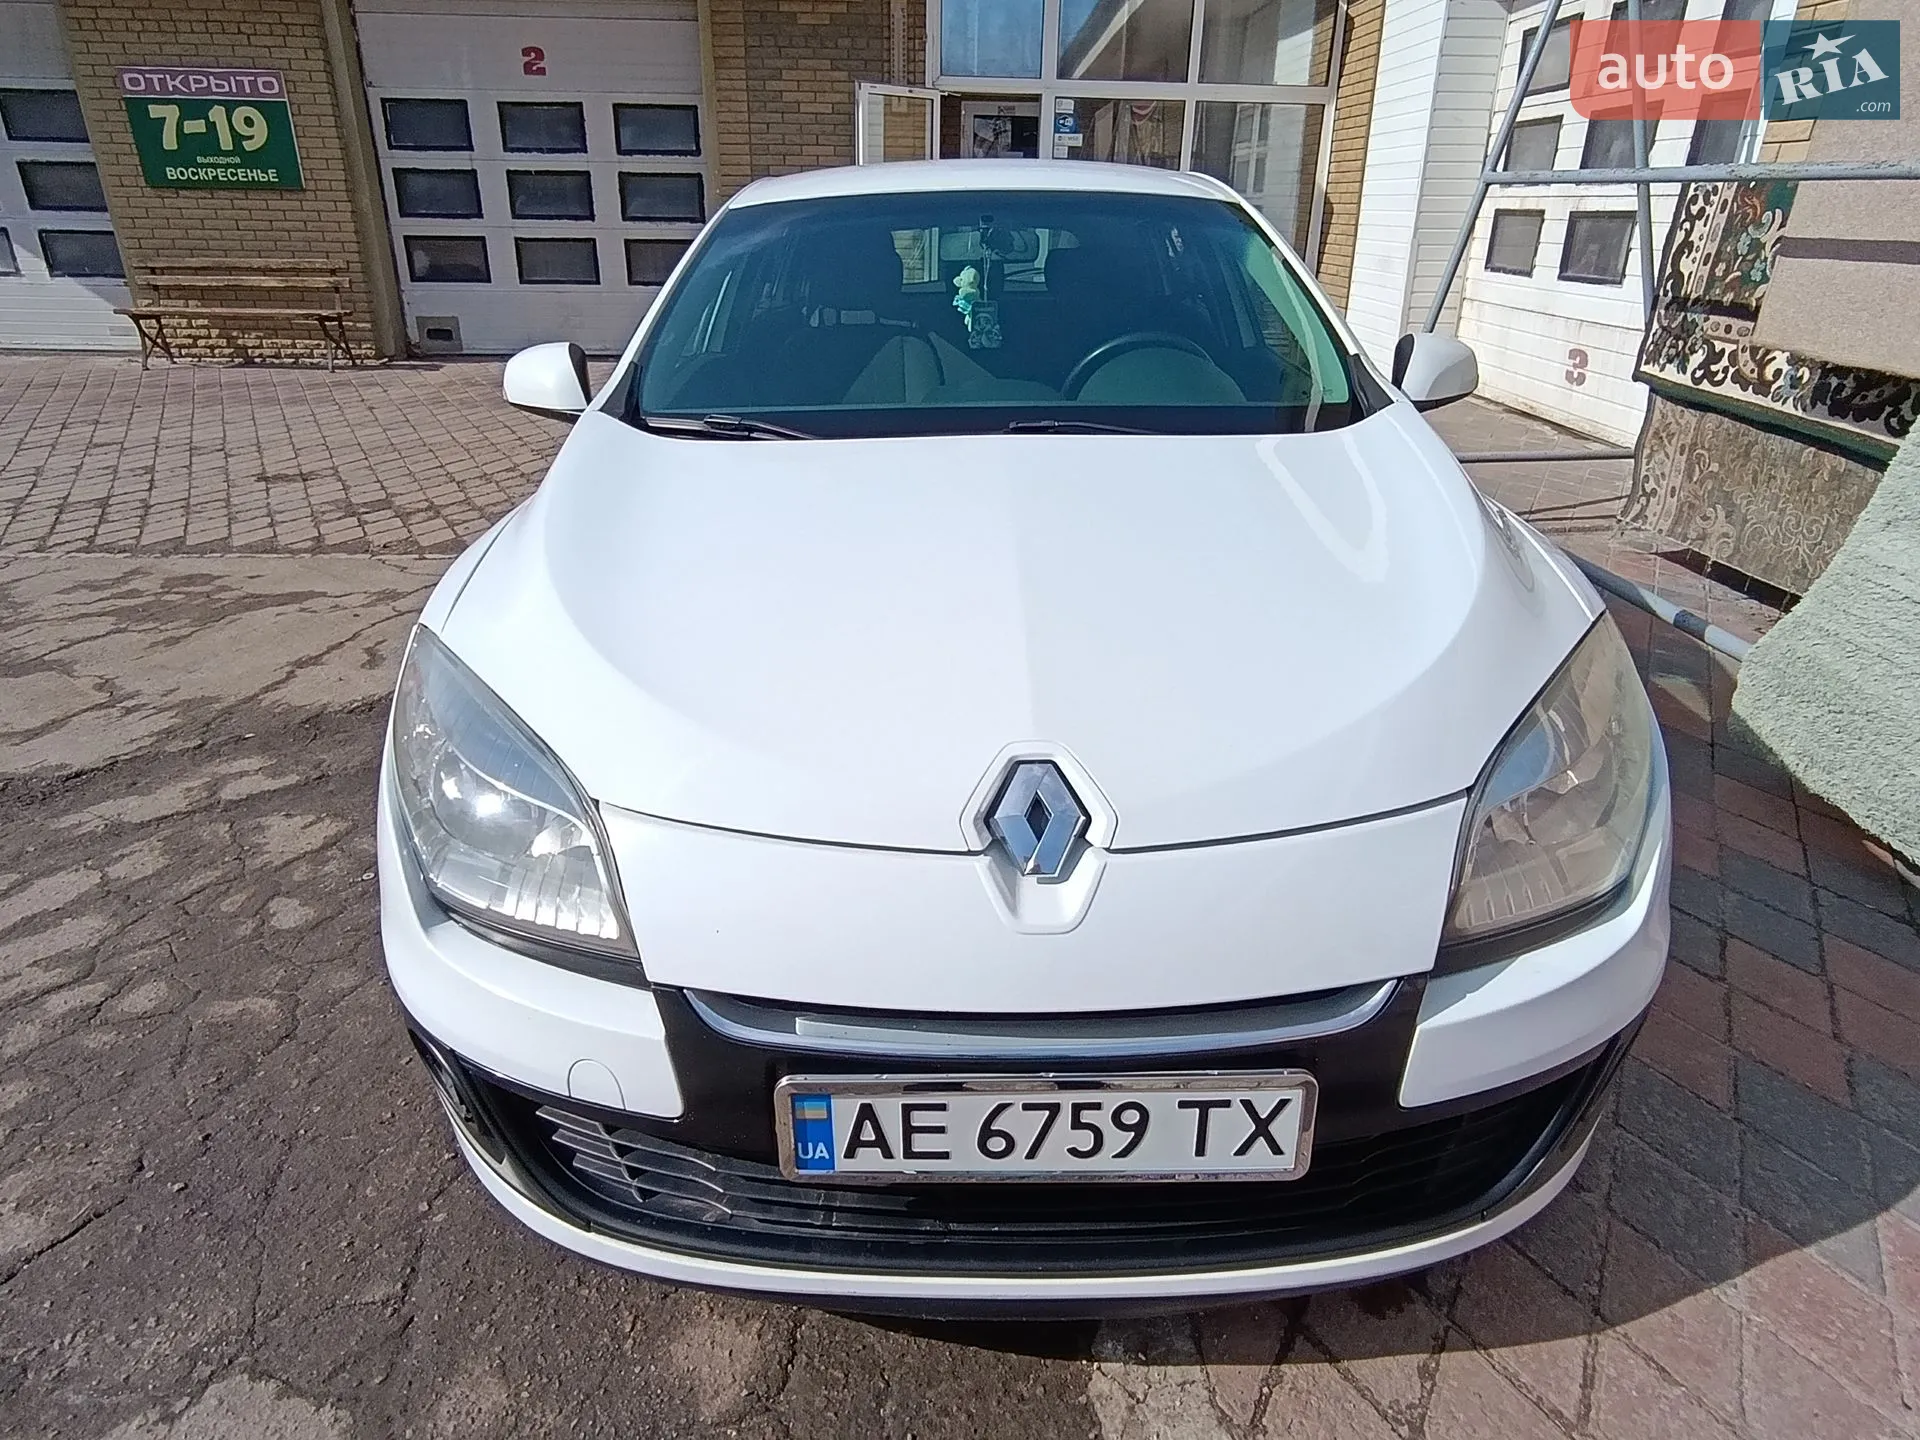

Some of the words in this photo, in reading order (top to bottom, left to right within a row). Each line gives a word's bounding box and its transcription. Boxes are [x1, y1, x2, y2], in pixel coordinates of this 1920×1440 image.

[521, 46, 547, 76] 2
[122, 73, 280, 94] ОТКРЫТО
[148, 104, 268, 151] 7-19
[165, 166, 280, 182] ВОСКРЕСЕНЬЕ
[1565, 348, 1589, 387] 3
[842, 1102, 952, 1161] AE
[976, 1101, 1151, 1160] 6759
[1177, 1097, 1294, 1157] TX
[798, 1143, 830, 1161] UA
